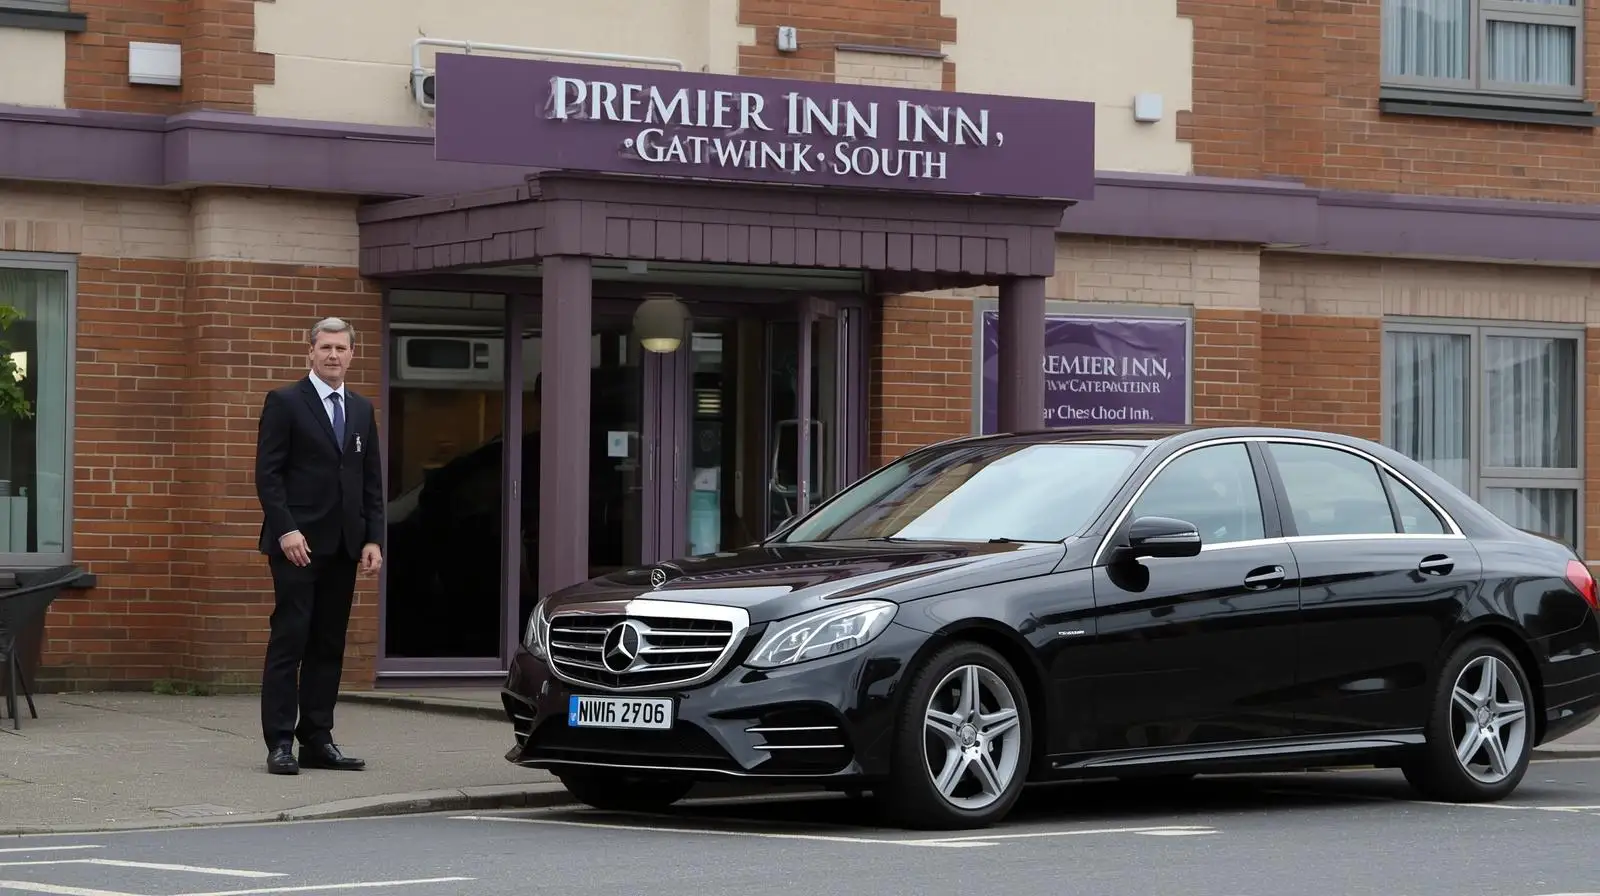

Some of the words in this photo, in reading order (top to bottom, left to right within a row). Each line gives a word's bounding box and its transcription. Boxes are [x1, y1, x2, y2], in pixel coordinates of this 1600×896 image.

[550, 77, 775, 131] PREMIER
[787, 92, 879, 139] INN
[897, 100, 1004, 147] INN,
